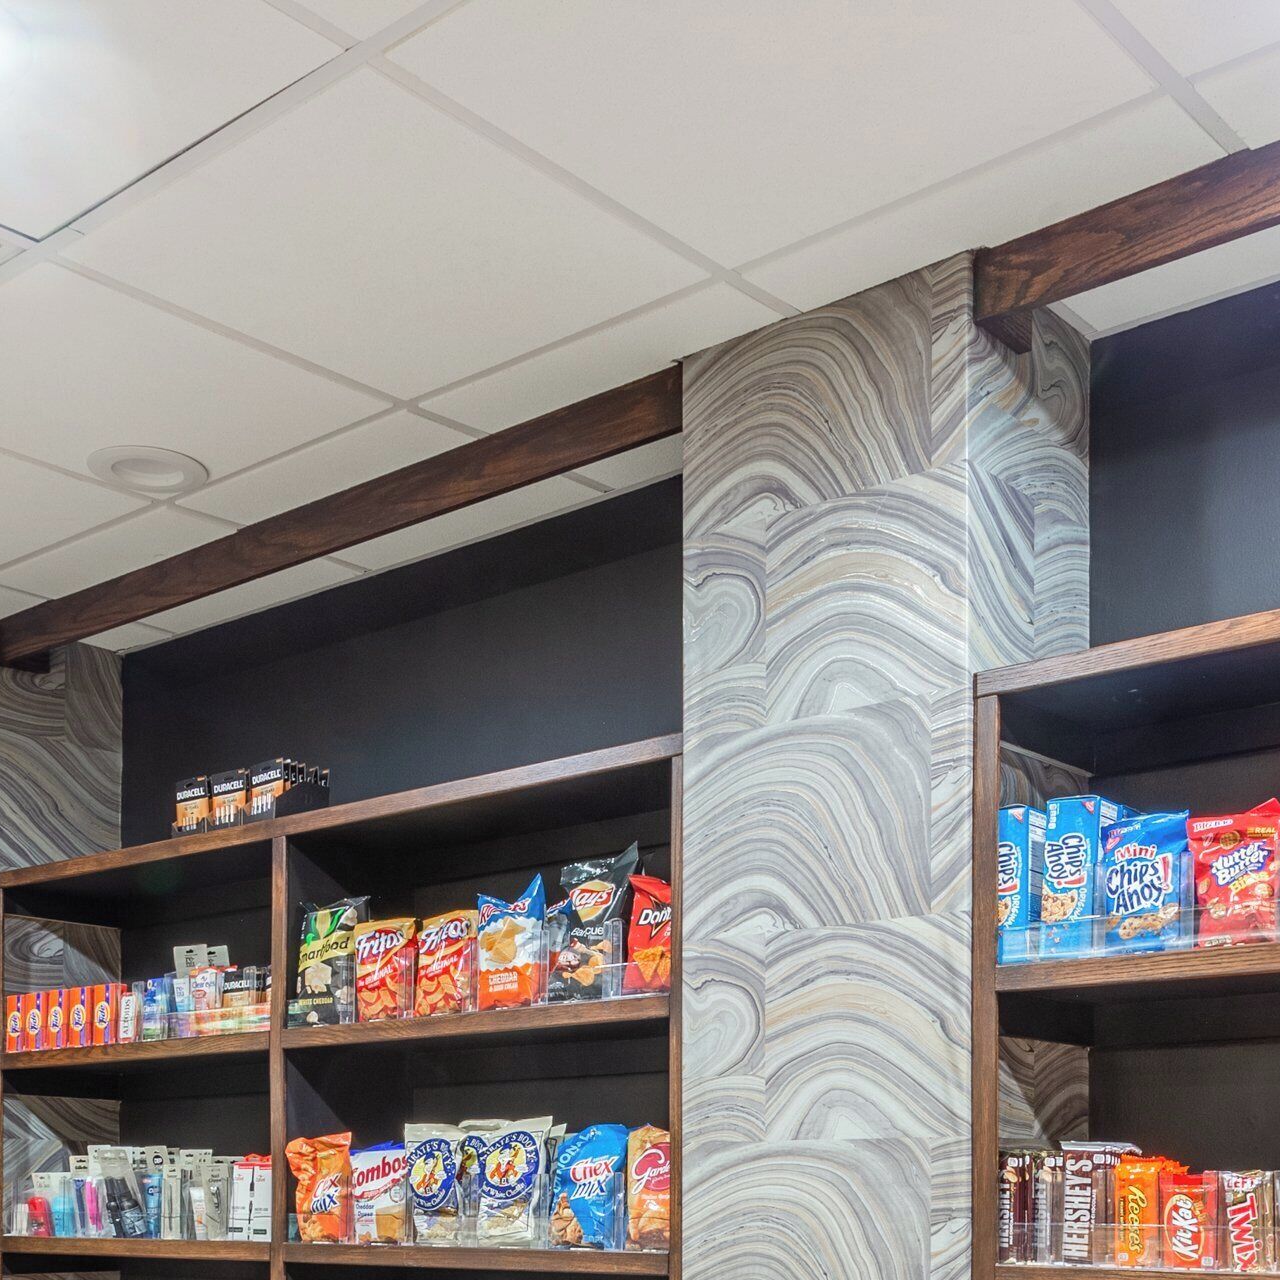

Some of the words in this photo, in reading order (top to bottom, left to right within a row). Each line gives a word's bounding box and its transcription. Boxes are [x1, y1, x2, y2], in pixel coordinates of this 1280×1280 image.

[213, 778, 244, 794] DURACELL
[251, 768, 281, 785] DURACELL
[177, 787, 206, 800] DURACELL
[1114, 845, 1157, 862] Mini
[1106, 860, 1159, 895] Chips
[356, 930, 404, 963] Fritos
[9, 1013, 21, 1036] Tide
[29, 1010, 40, 1034] Tide
[51, 1007, 62, 1031] Tide
[73, 1004, 85, 1029] Tide
[97, 1002, 109, 1026] Tide
[1062, 1158, 1093, 1258] HERSHEY'S
[1128, 1185, 1147, 1253] Reese's
